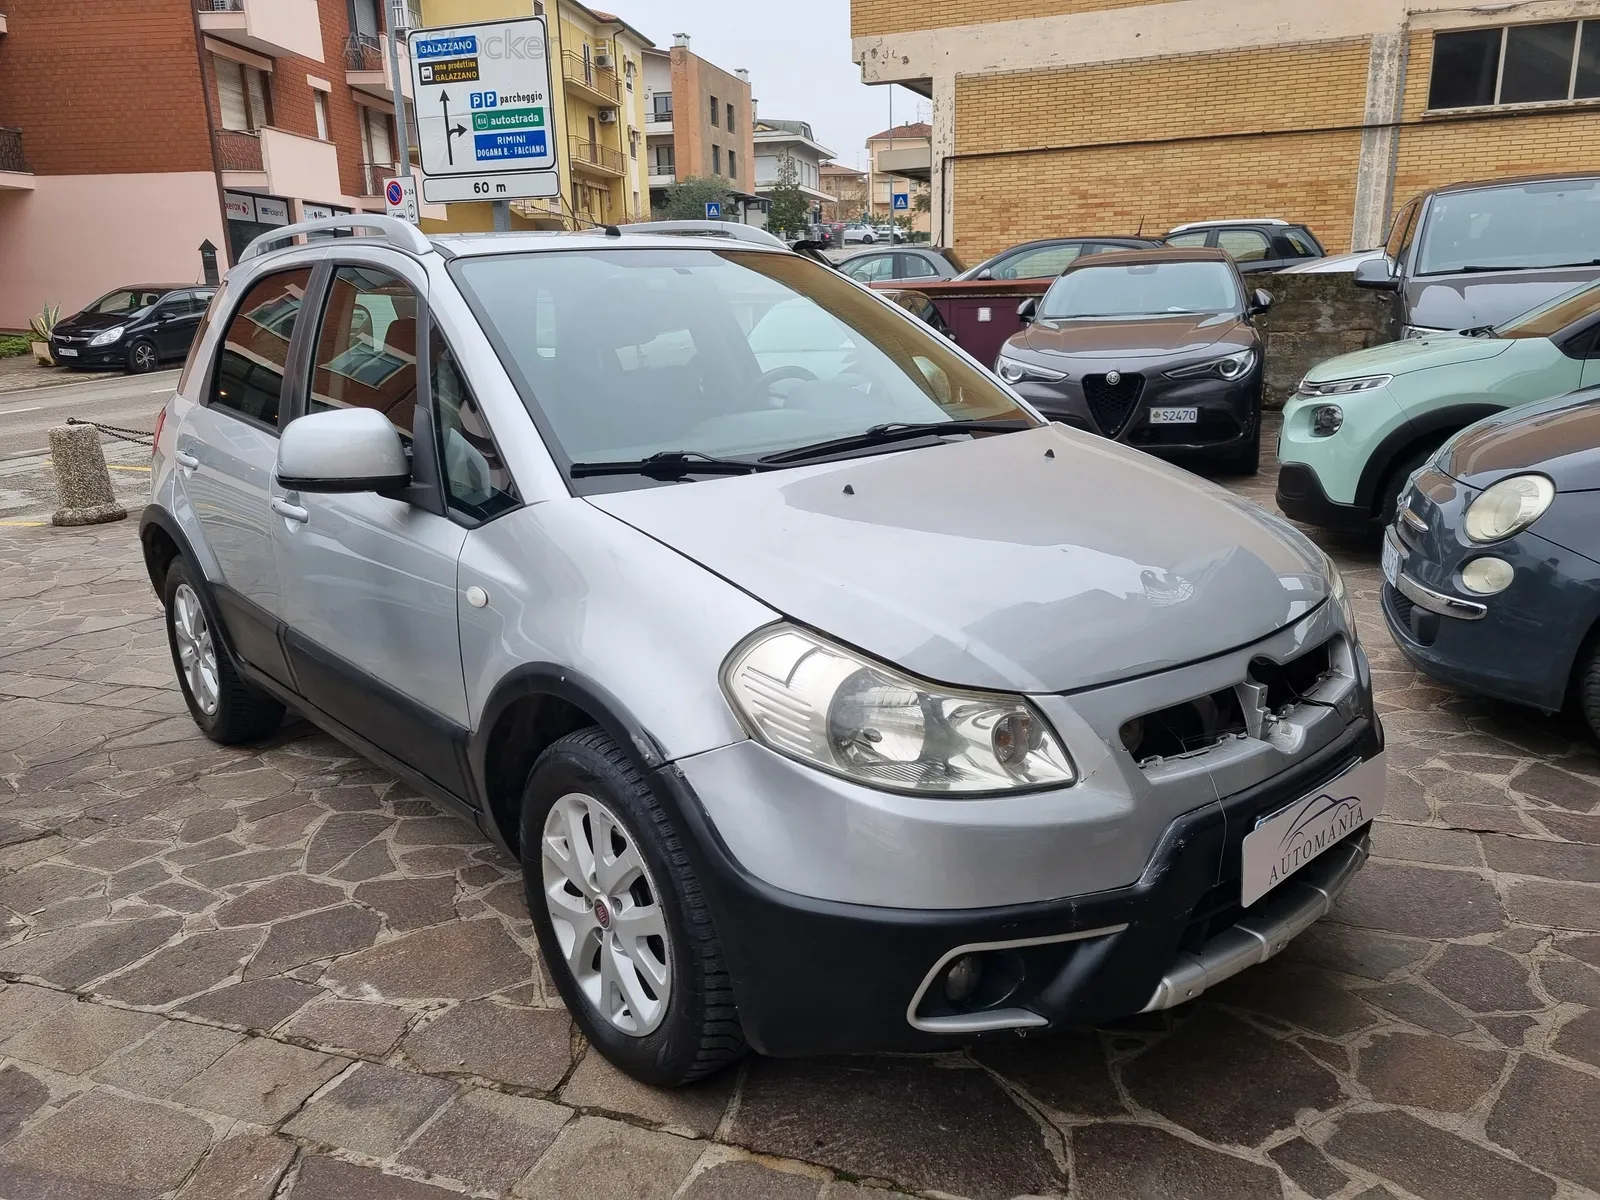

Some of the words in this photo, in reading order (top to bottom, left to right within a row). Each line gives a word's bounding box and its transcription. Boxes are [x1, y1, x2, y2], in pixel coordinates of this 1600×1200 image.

[420, 40, 473, 54] GALAZZANO
[448, 59, 476, 71] produttiva
[435, 70, 478, 82] GALAZZANO
[499, 90, 543, 106] parcheggio
[490, 112, 539, 126] autostrada
[497, 134, 526, 145] RIMINI
[477, 148, 503, 158] DOGANA
[514, 144, 545, 155] FALCIANO
[473, 181, 490, 194] 60
[496, 183, 507, 193] m
[268, 207, 284, 217] Roland
[1162, 410, 1196, 421] S2470
[1268, 806, 1364, 886] AUTOMANIA
